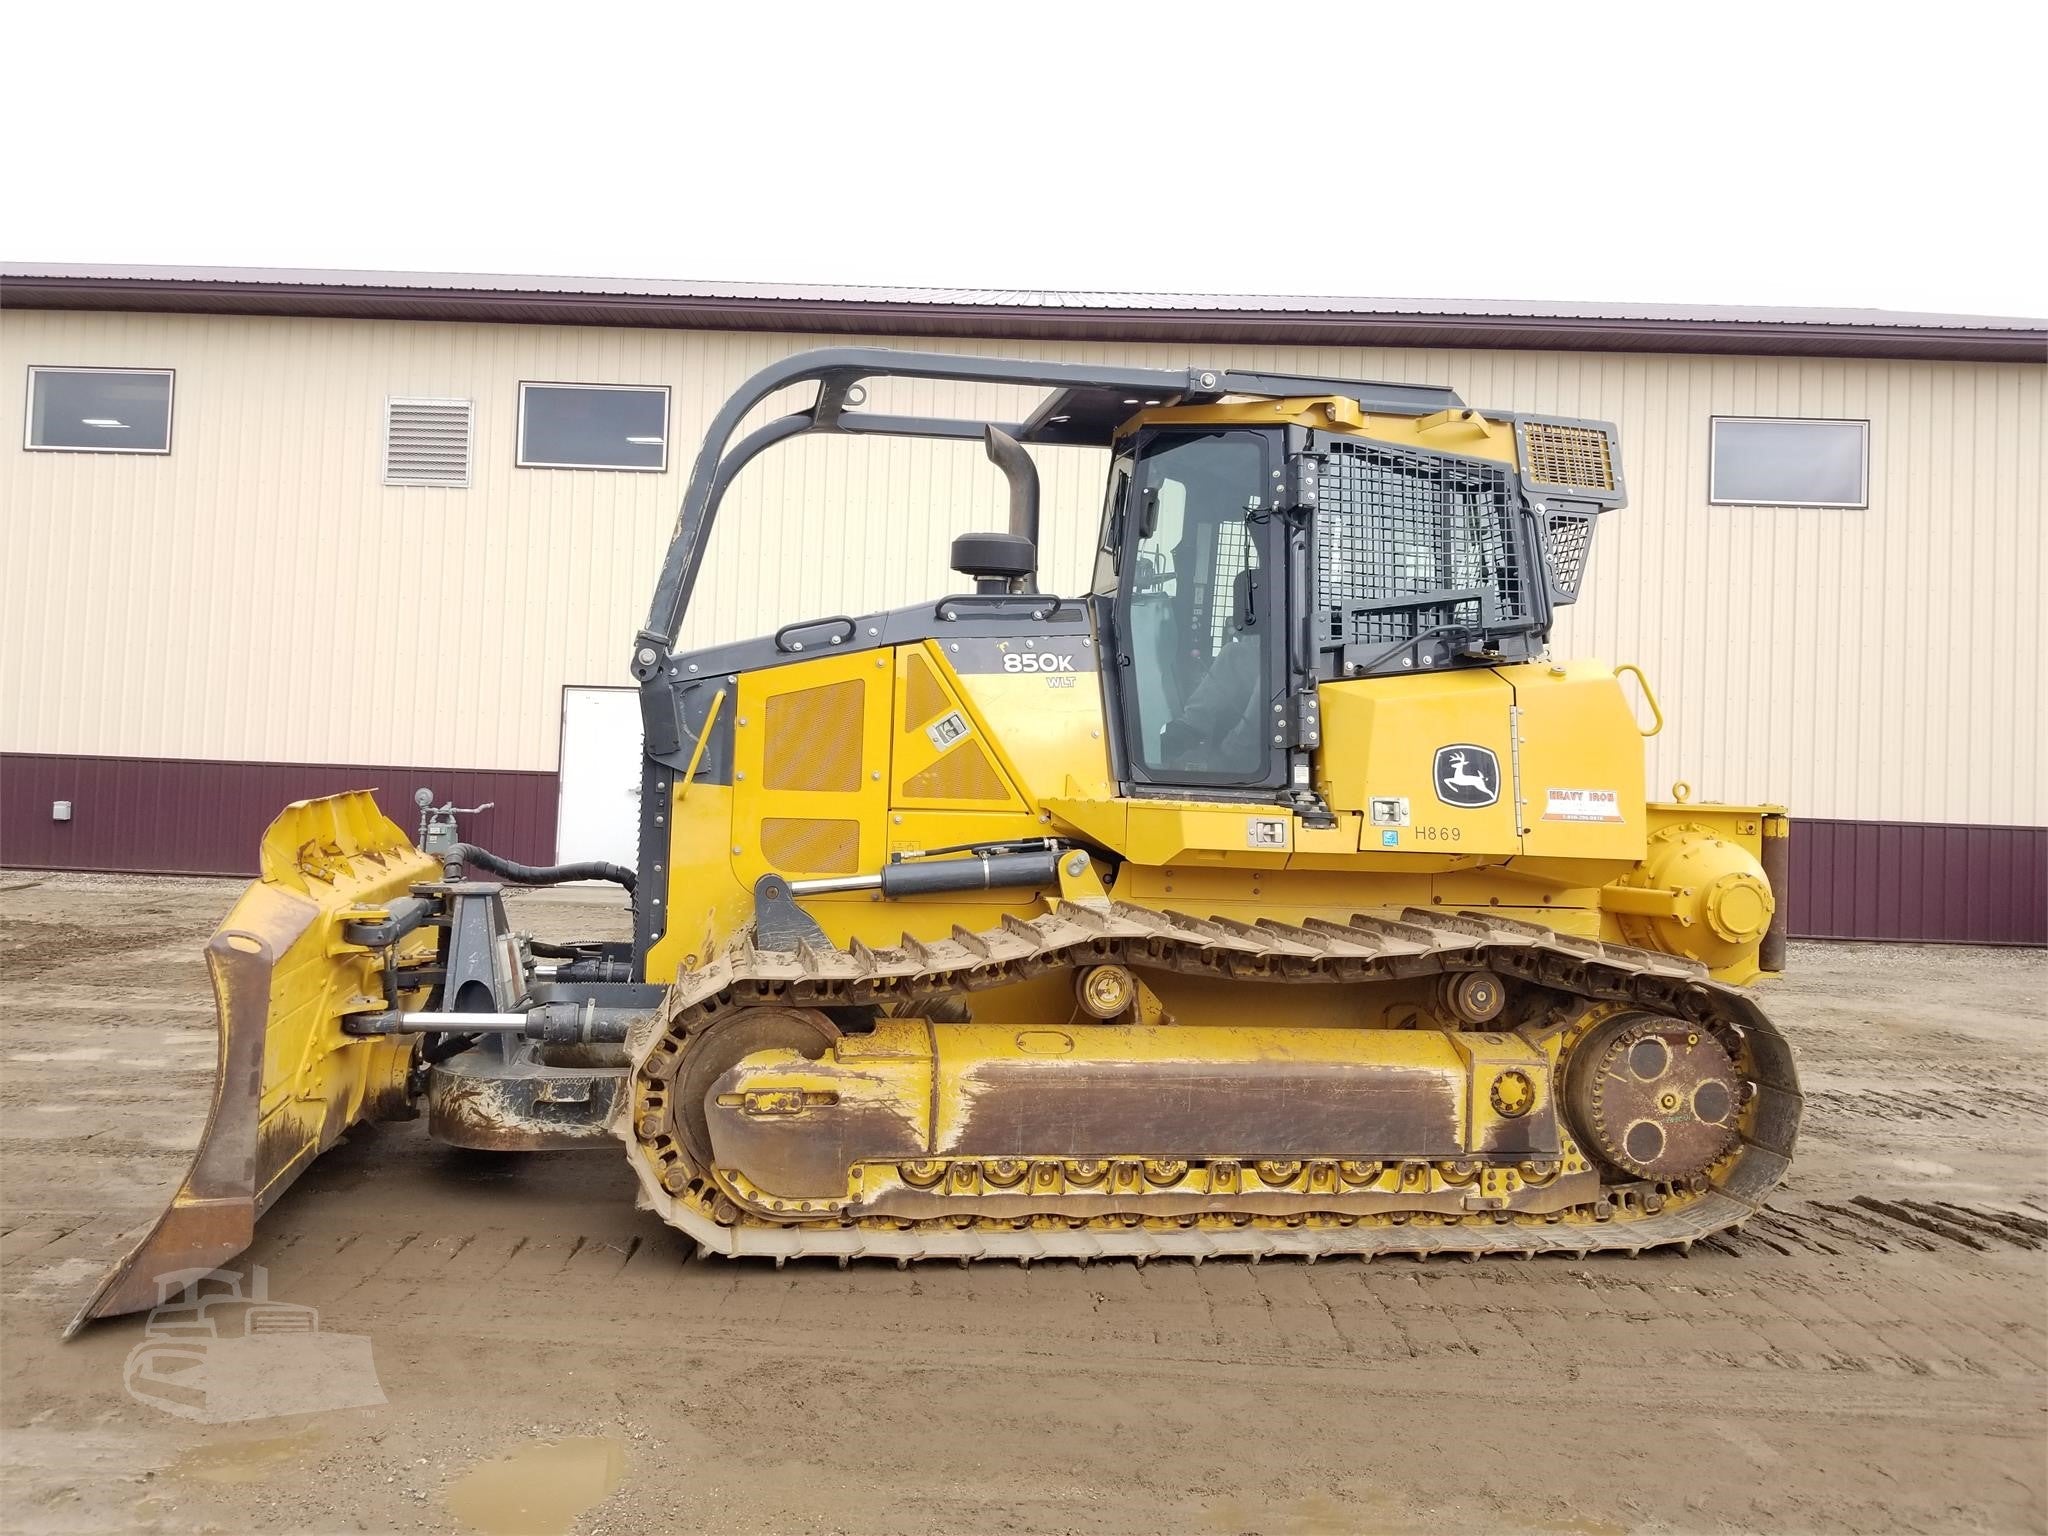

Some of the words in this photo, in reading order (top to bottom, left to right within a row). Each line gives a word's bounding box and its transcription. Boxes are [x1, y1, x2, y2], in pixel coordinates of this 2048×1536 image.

[1003, 652, 1077, 673] 850K
[1046, 676, 1076, 688] WLT
[1415, 826, 1460, 841] H869
